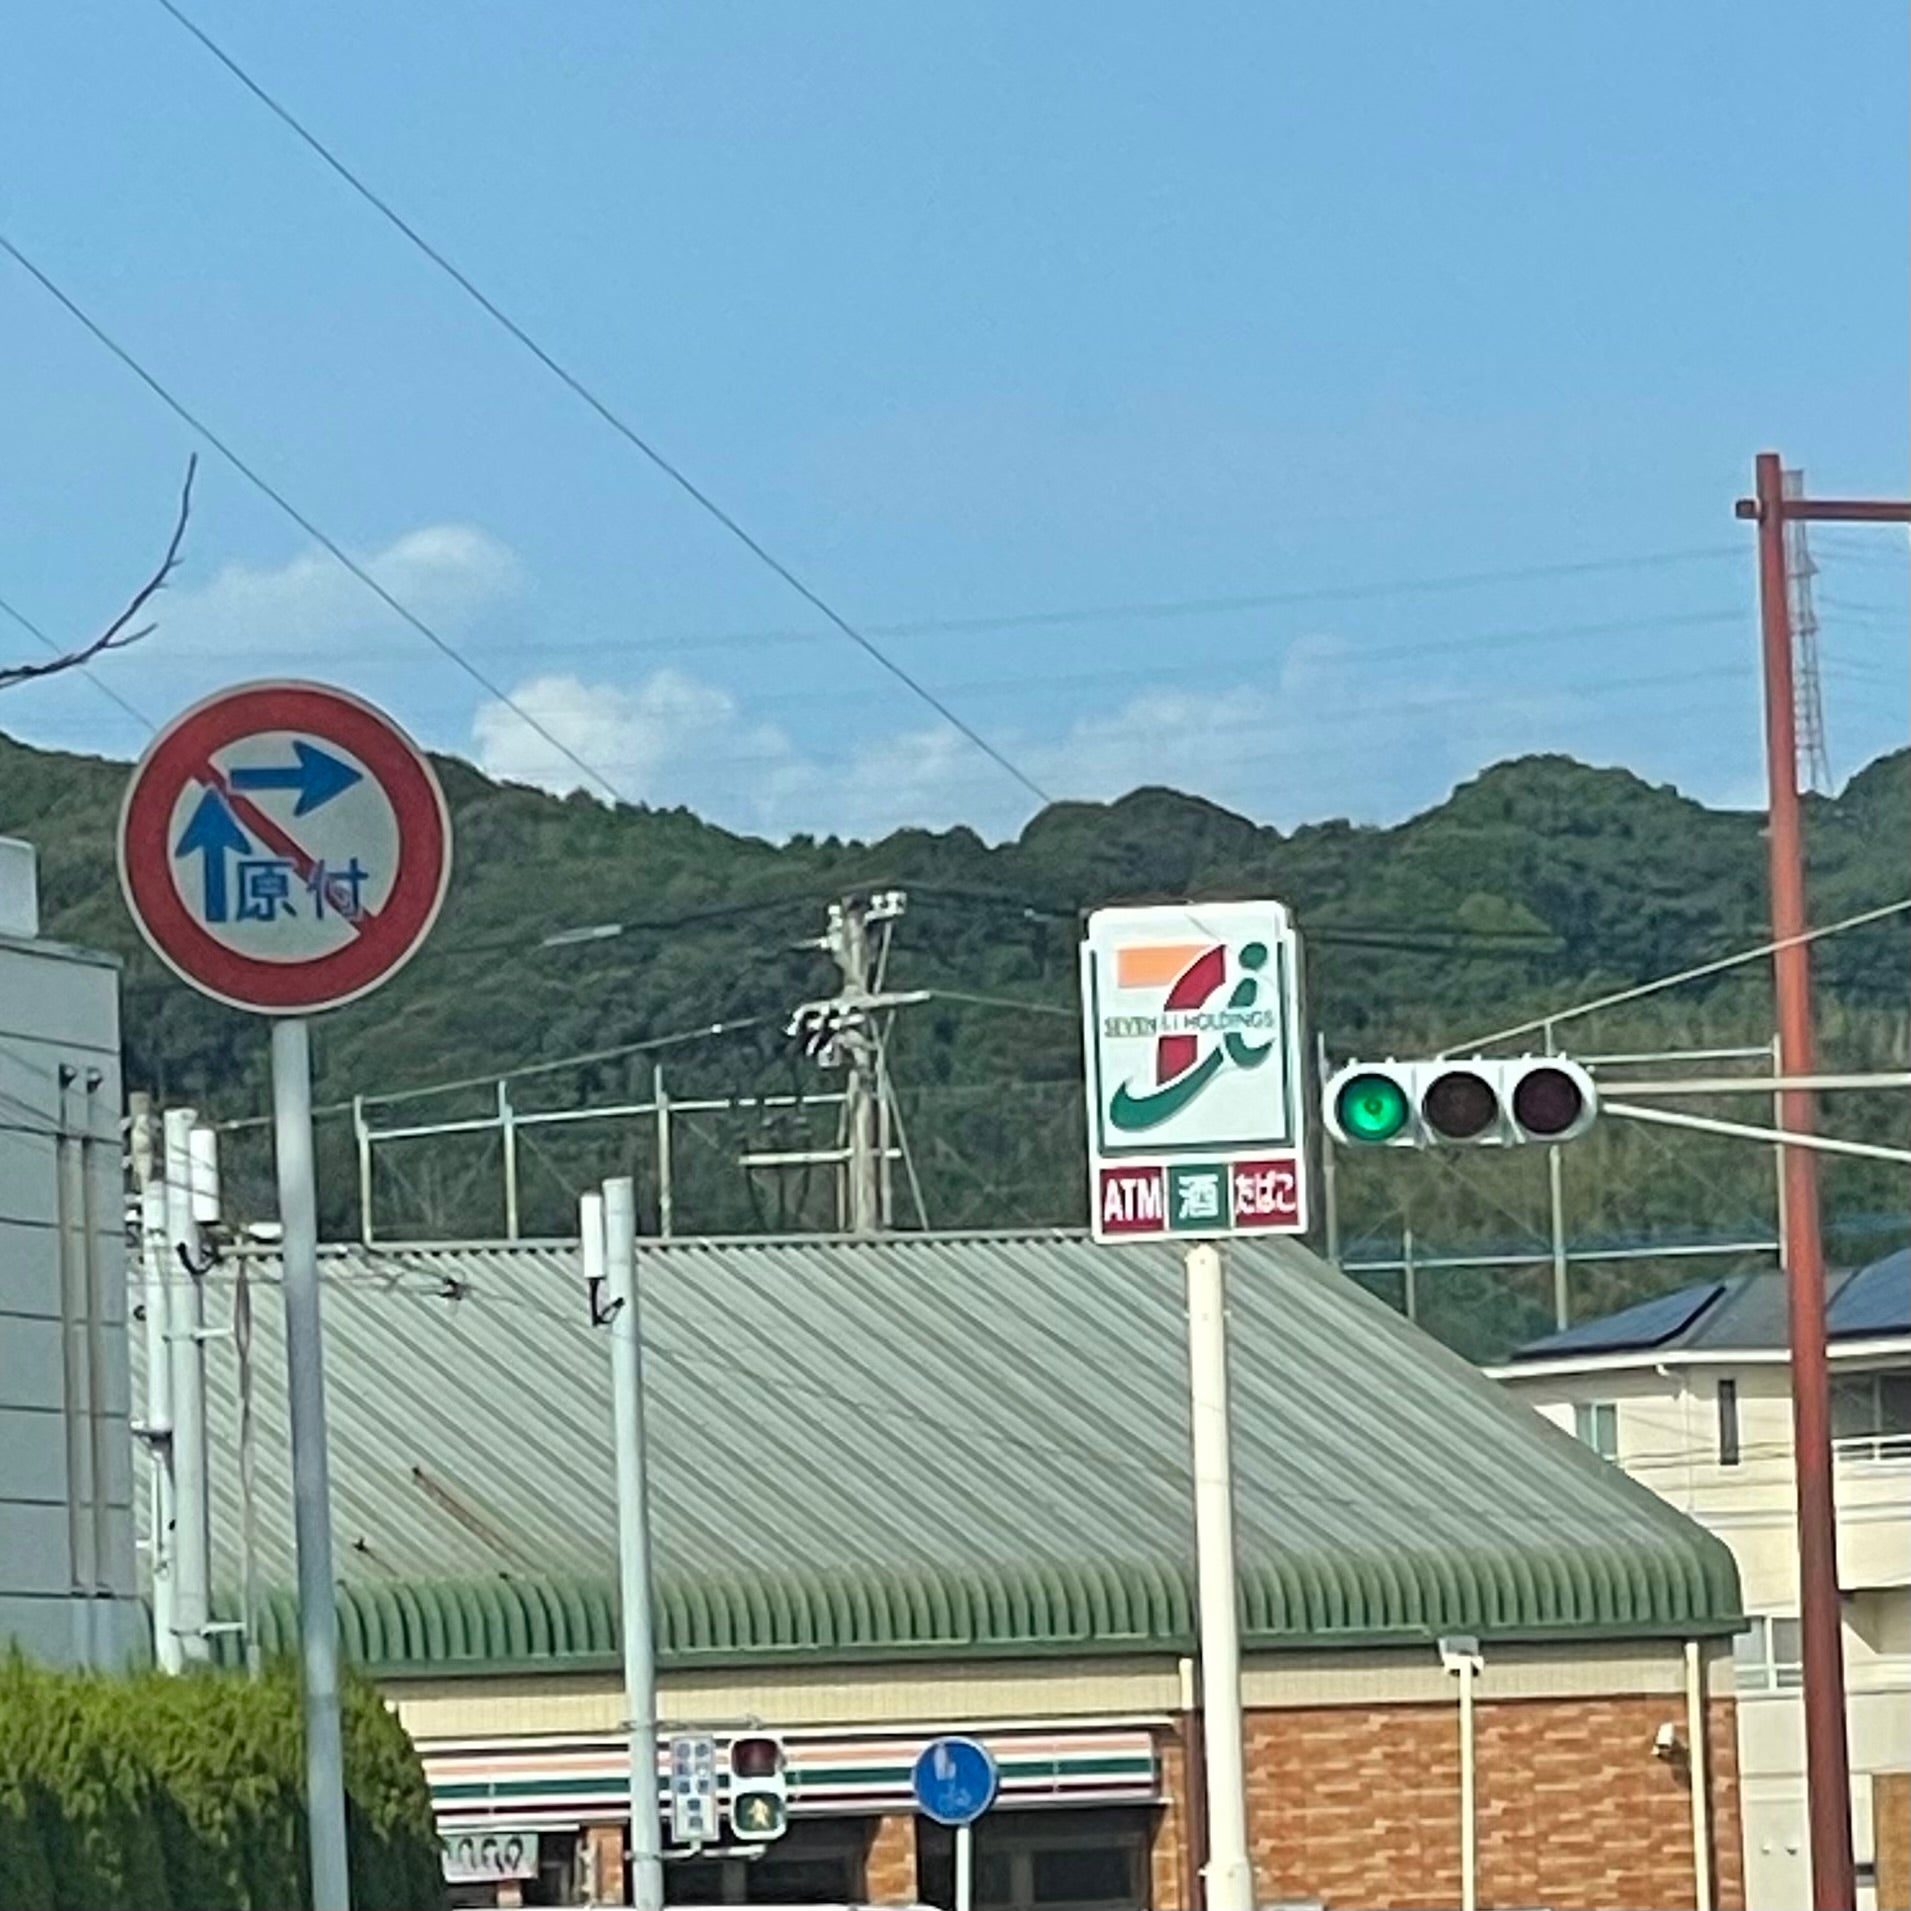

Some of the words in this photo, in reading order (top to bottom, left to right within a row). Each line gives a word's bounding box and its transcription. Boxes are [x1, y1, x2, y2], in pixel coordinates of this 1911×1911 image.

[236, 857, 369, 921] 原付
[1104, 1016, 1157, 1038] SEVEN
[1184, 1009, 1274, 1031] HOLDINGS
[1104, 1177, 1162, 1222] ATM
[1178, 1174, 1219, 1219] 酒
[1235, 1170, 1296, 1214] たばこ
